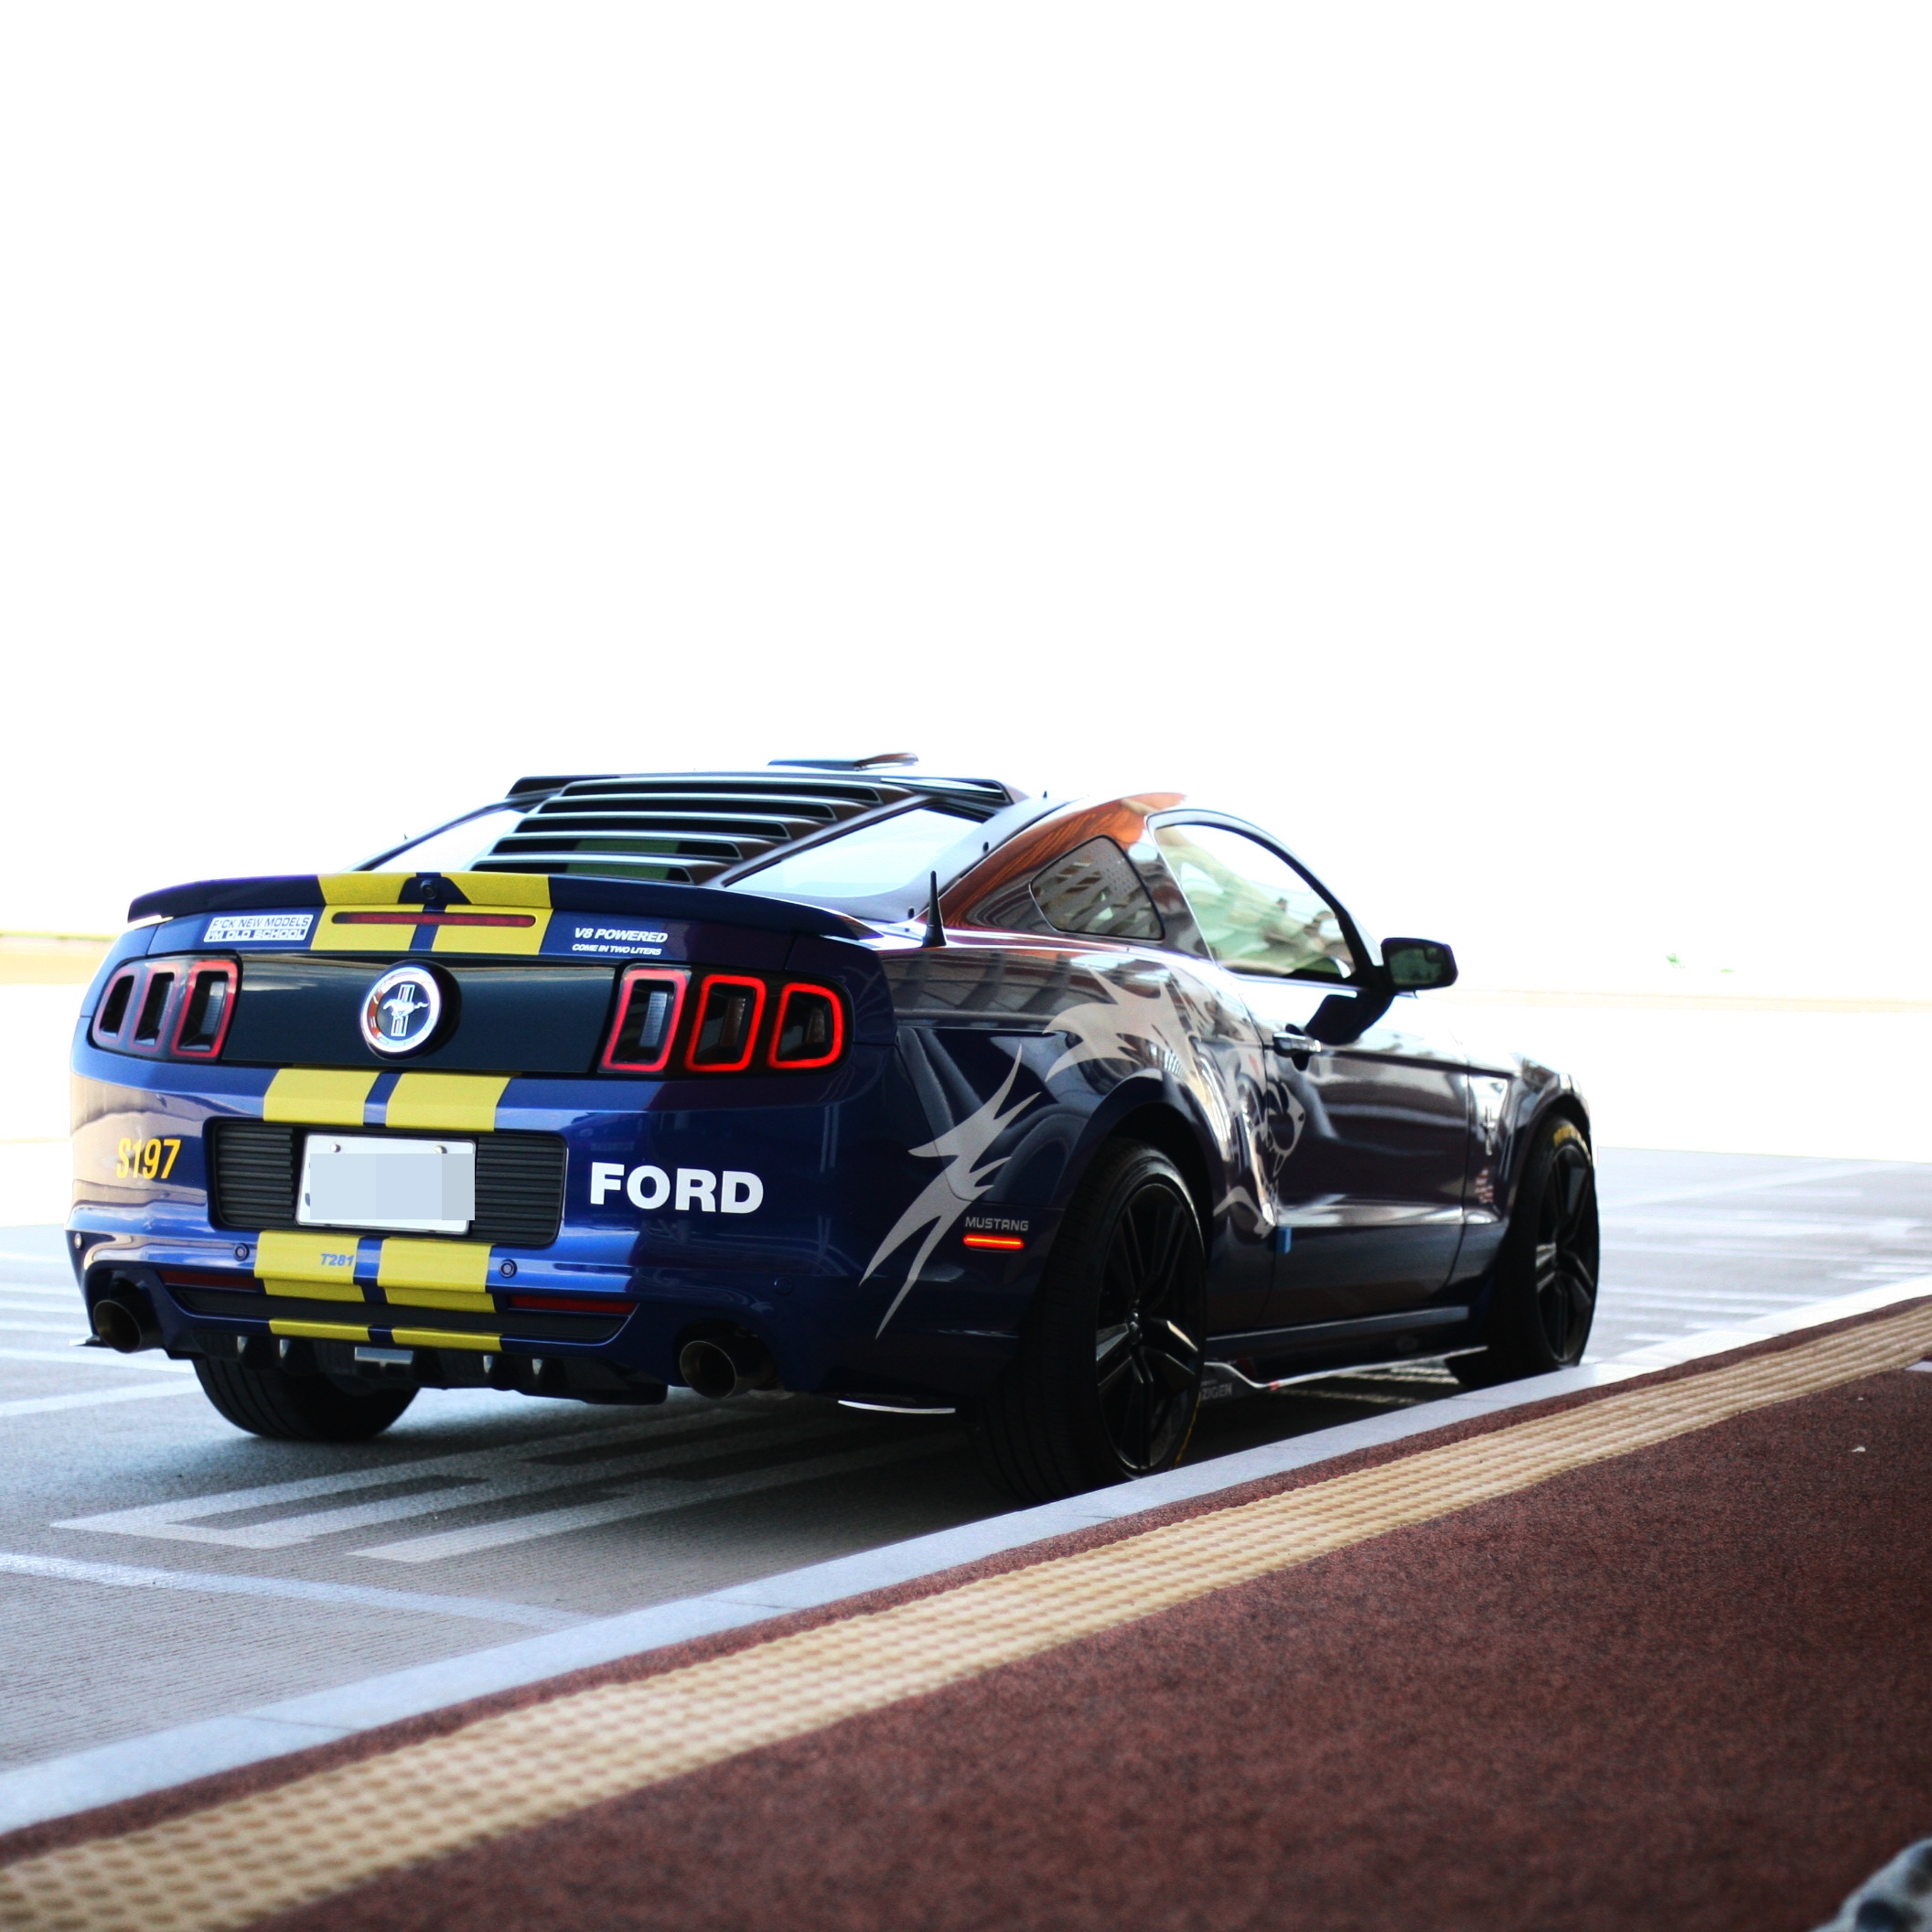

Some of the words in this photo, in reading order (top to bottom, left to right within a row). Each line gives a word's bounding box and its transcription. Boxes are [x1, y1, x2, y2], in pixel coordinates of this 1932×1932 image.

[238, 918, 263, 928] NEW
[263, 917, 310, 927] MODELS
[225, 929, 252, 939] OLD
[252, 928, 305, 939] SCHOOL
[574, 928, 594, 939] V8
[595, 928, 668, 943] POWERED
[598, 945, 610, 953] IN
[610, 946, 630, 954] TWO
[630, 947, 662, 956] LITERS
[116, 1137, 181, 1179] S197
[590, 1162, 764, 1214] FORD
[965, 1217, 1029, 1231] MUSTANG
[321, 1253, 354, 1266] T281
